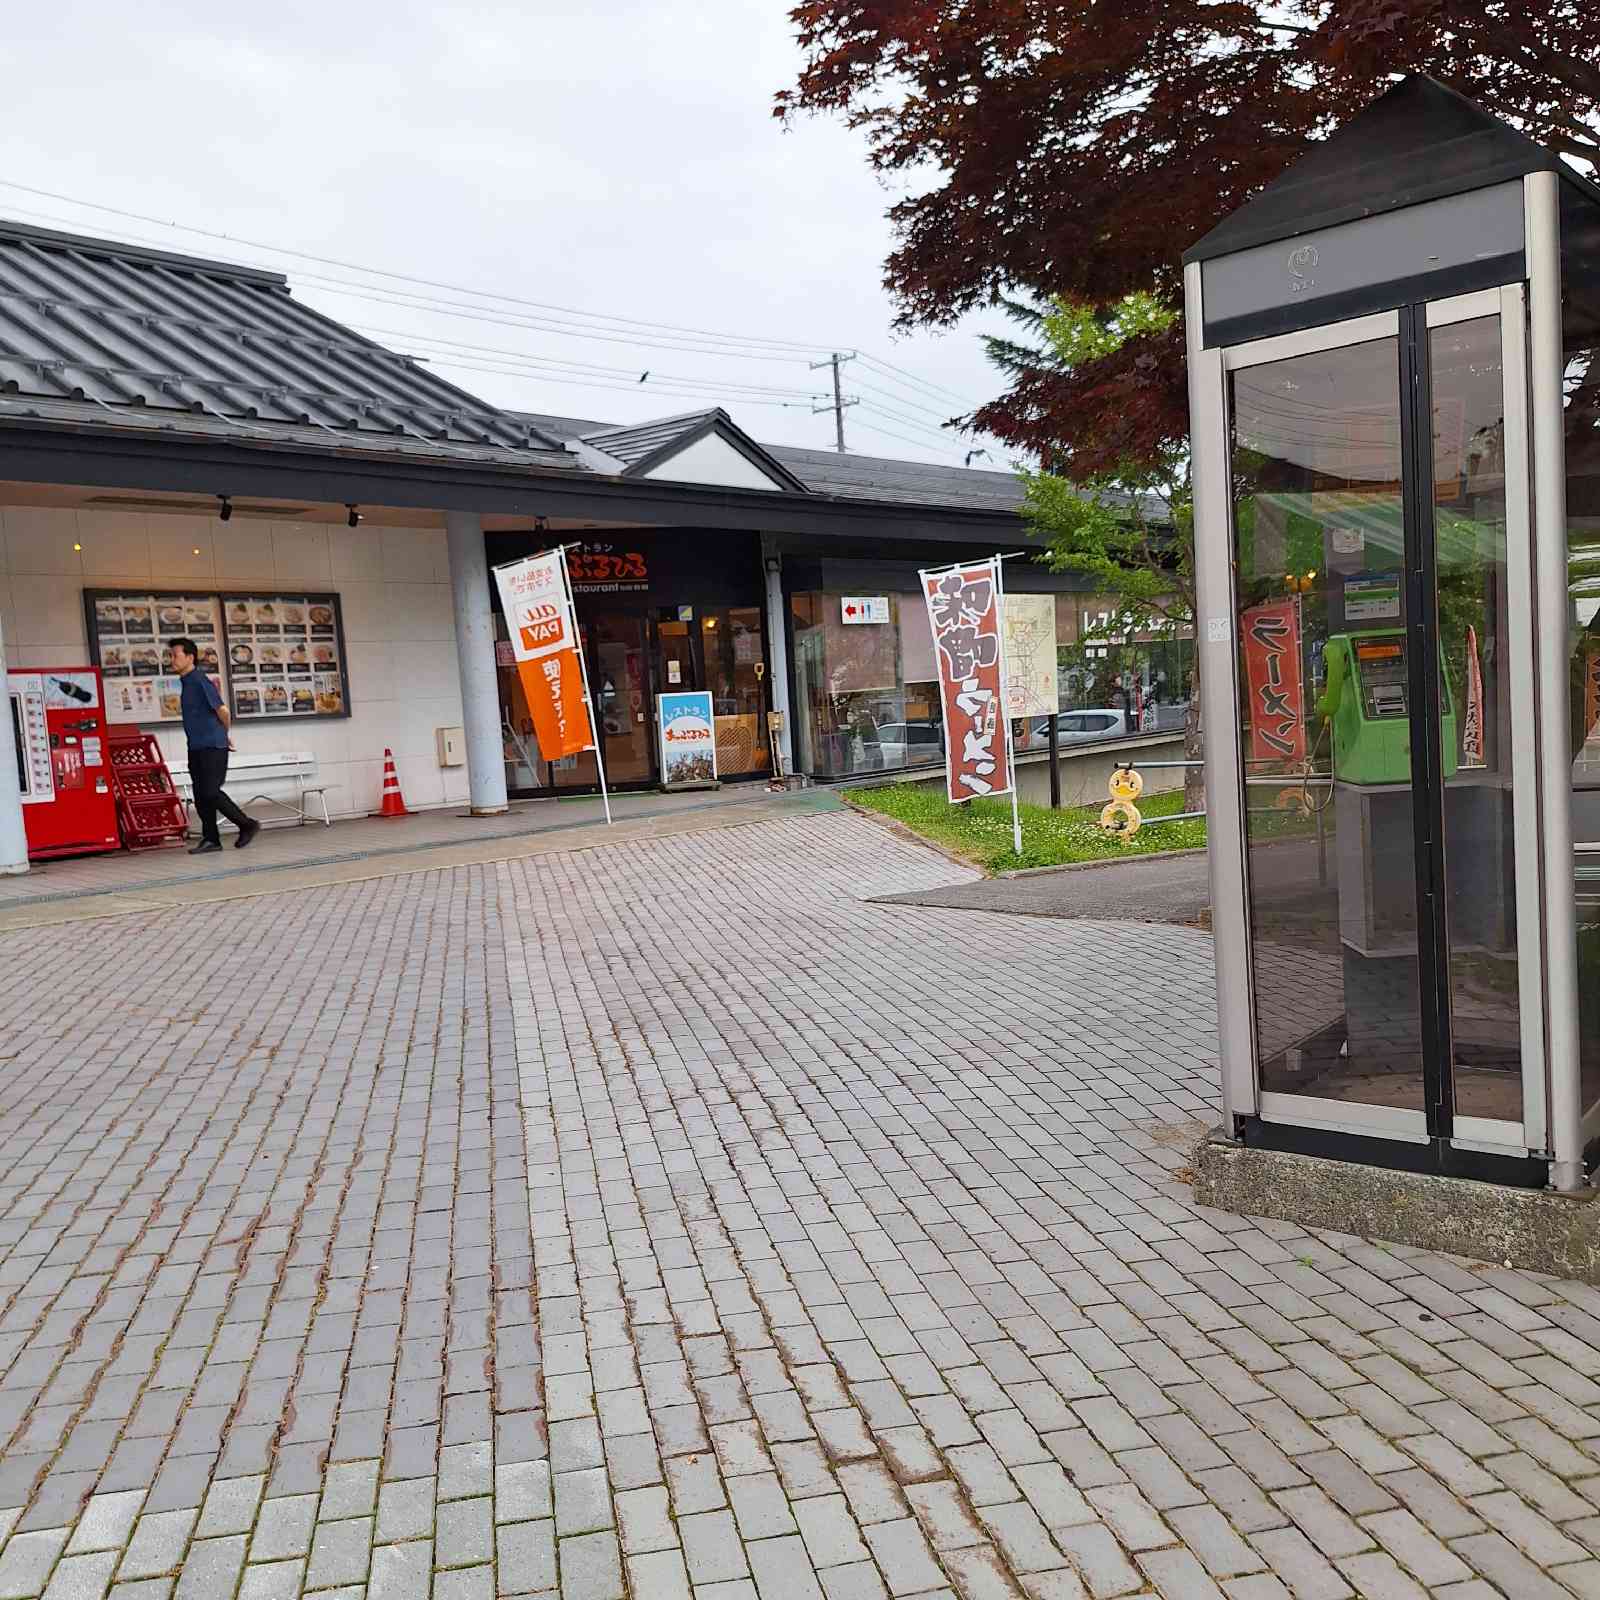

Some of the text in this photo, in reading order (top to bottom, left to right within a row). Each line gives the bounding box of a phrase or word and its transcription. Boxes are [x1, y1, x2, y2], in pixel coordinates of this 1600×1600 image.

[664, 706, 709, 720] レストラン
